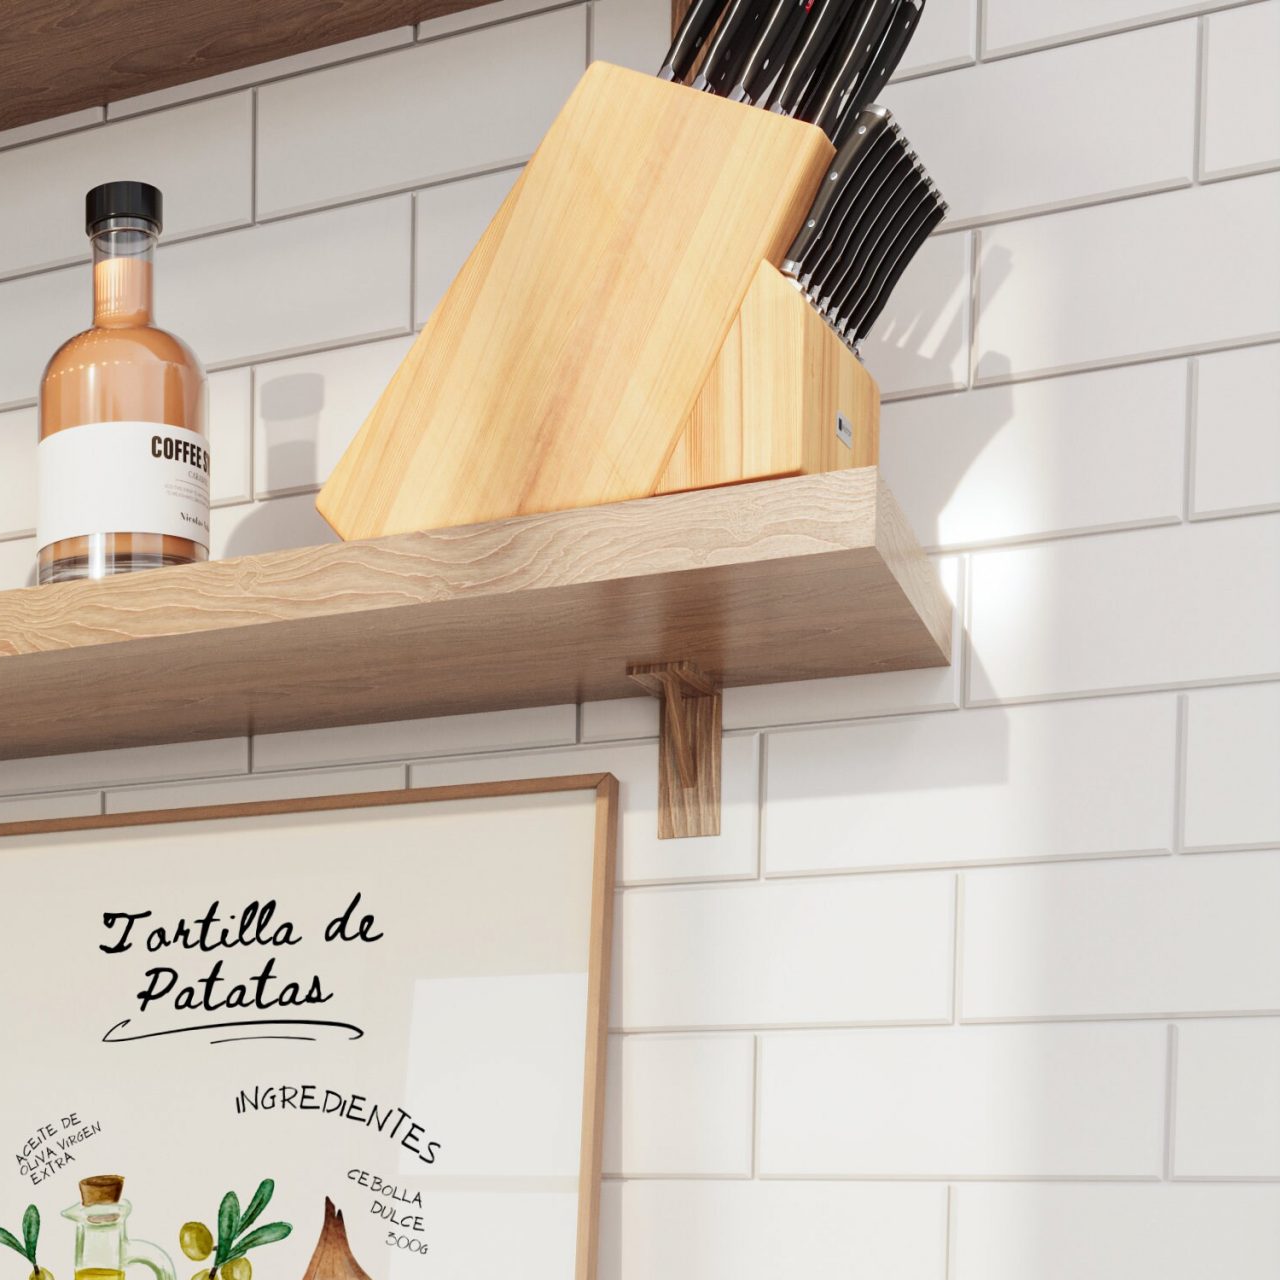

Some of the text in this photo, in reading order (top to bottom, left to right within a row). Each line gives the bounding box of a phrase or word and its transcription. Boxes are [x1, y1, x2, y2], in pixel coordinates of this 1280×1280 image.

[150, 434, 202, 470] COFFEE
[99, 891, 384, 954] Tortilla de
[136, 957, 334, 1012] Patatas
[15, 1112, 82, 1165] ACEITE DE
[235, 1085, 442, 1164] INGREDIENTES
[19, 1121, 101, 1176] OLIVA VIRGEN
[29, 1151, 76, 1186] EXTRA
[347, 1168, 422, 1208] CEBOLLA
[370, 1200, 425, 1232] DULCE
[385, 1231, 429, 1255] 300G
